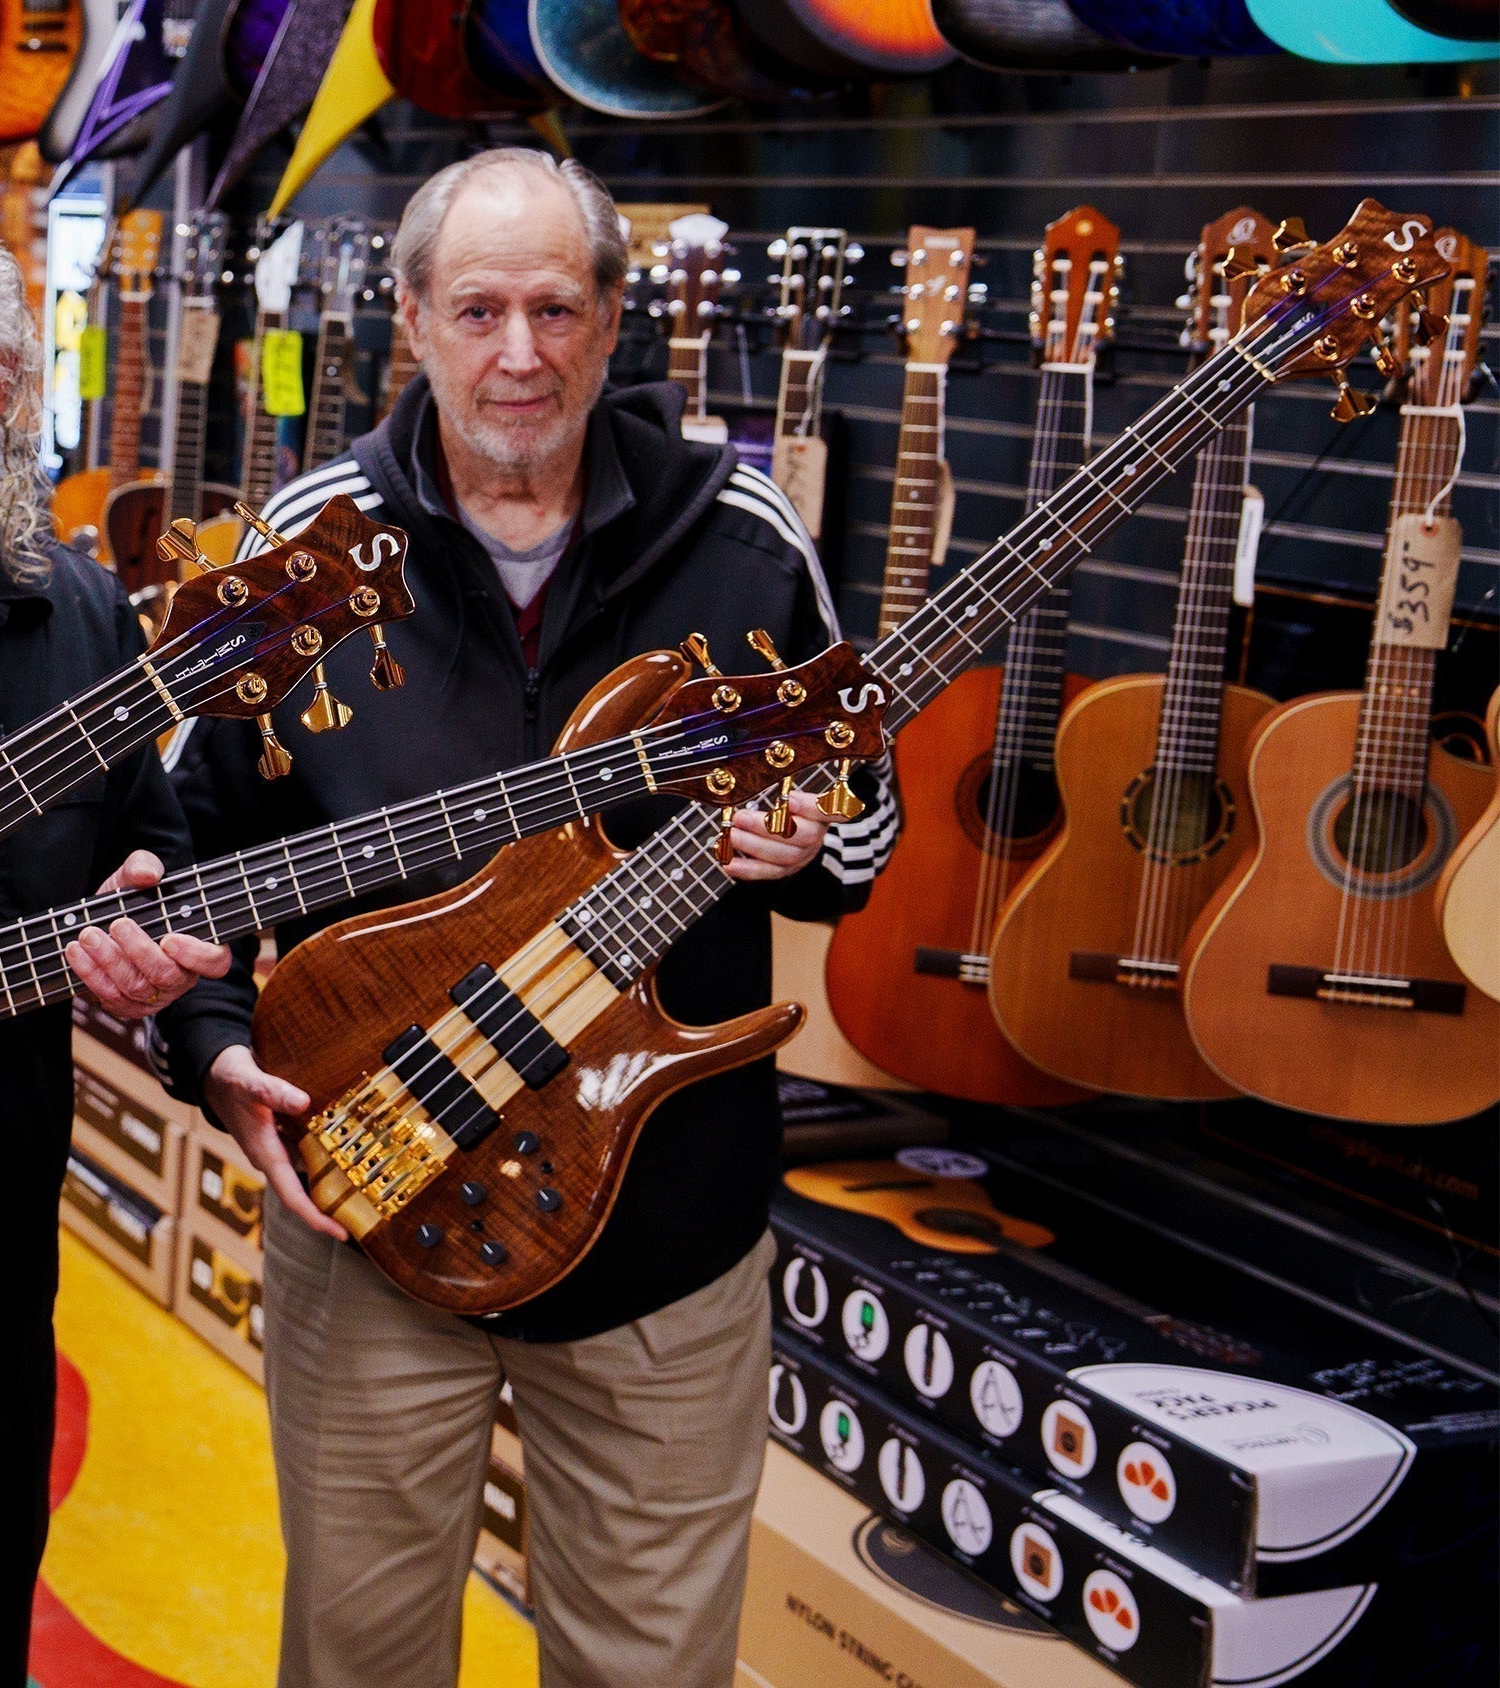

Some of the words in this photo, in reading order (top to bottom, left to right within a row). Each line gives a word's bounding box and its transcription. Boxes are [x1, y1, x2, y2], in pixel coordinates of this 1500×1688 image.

[1383, 220, 1428, 252] S
[348, 532, 402, 572] S
[174, 634, 247, 680] SMITH
[837, 682, 887, 714] S
